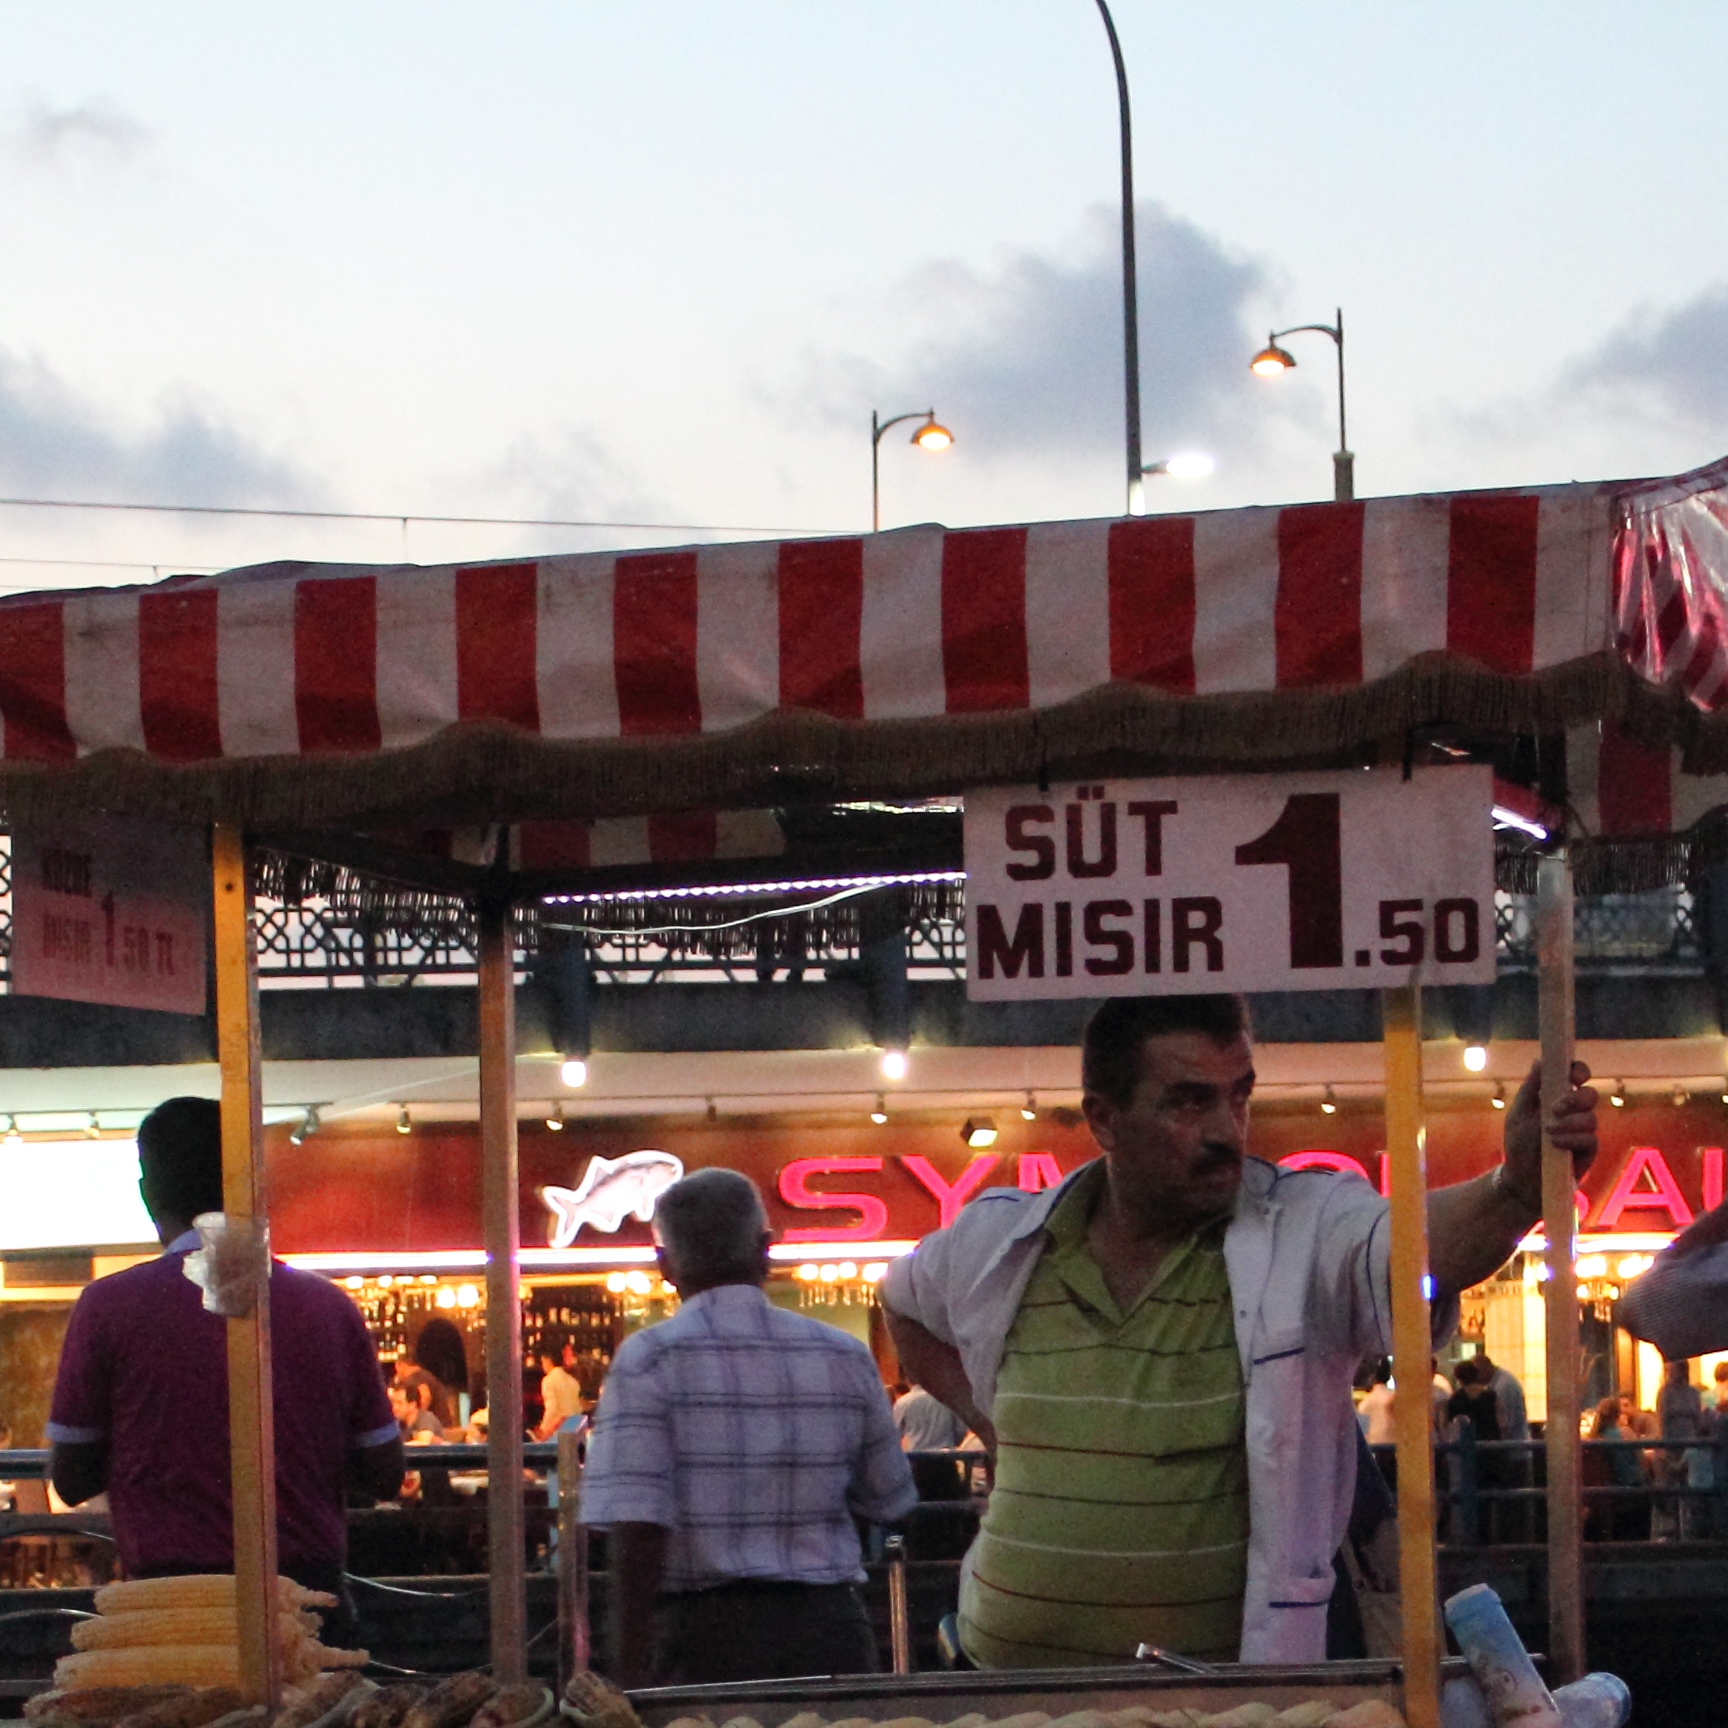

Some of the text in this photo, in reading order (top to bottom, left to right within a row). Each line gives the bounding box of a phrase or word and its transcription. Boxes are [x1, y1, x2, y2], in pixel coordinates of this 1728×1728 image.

[976, 792, 1480, 980] MISIR 1.50
[1004, 785, 1178, 881] SÜT
